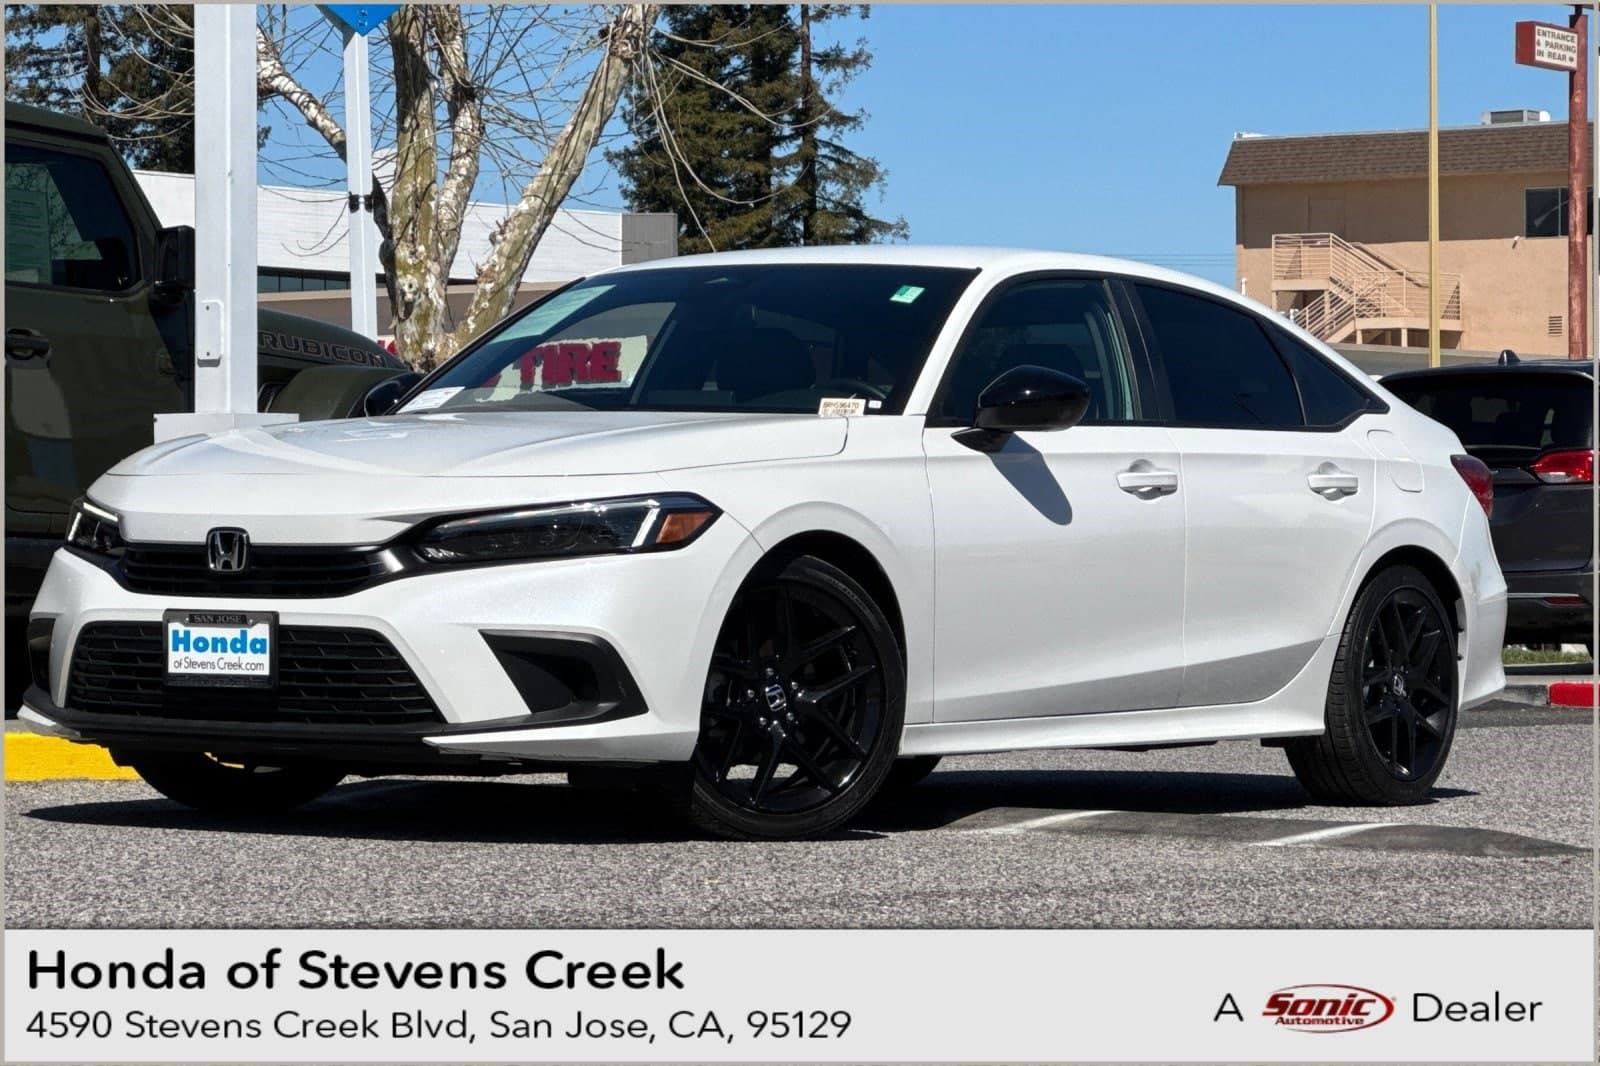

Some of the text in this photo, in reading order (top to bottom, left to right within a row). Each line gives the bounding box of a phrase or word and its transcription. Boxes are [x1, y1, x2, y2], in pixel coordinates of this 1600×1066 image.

[1537, 29, 1575, 43] ENTRANCE
[1545, 40, 1576, 53] PARKING
[1537, 50, 1567, 61] IN REAR
[258, 329, 387, 368] RUBICON
[194, 614, 242, 625] SAN JOSE
[171, 629, 268, 655] Honda
[173, 659, 182, 669] of
